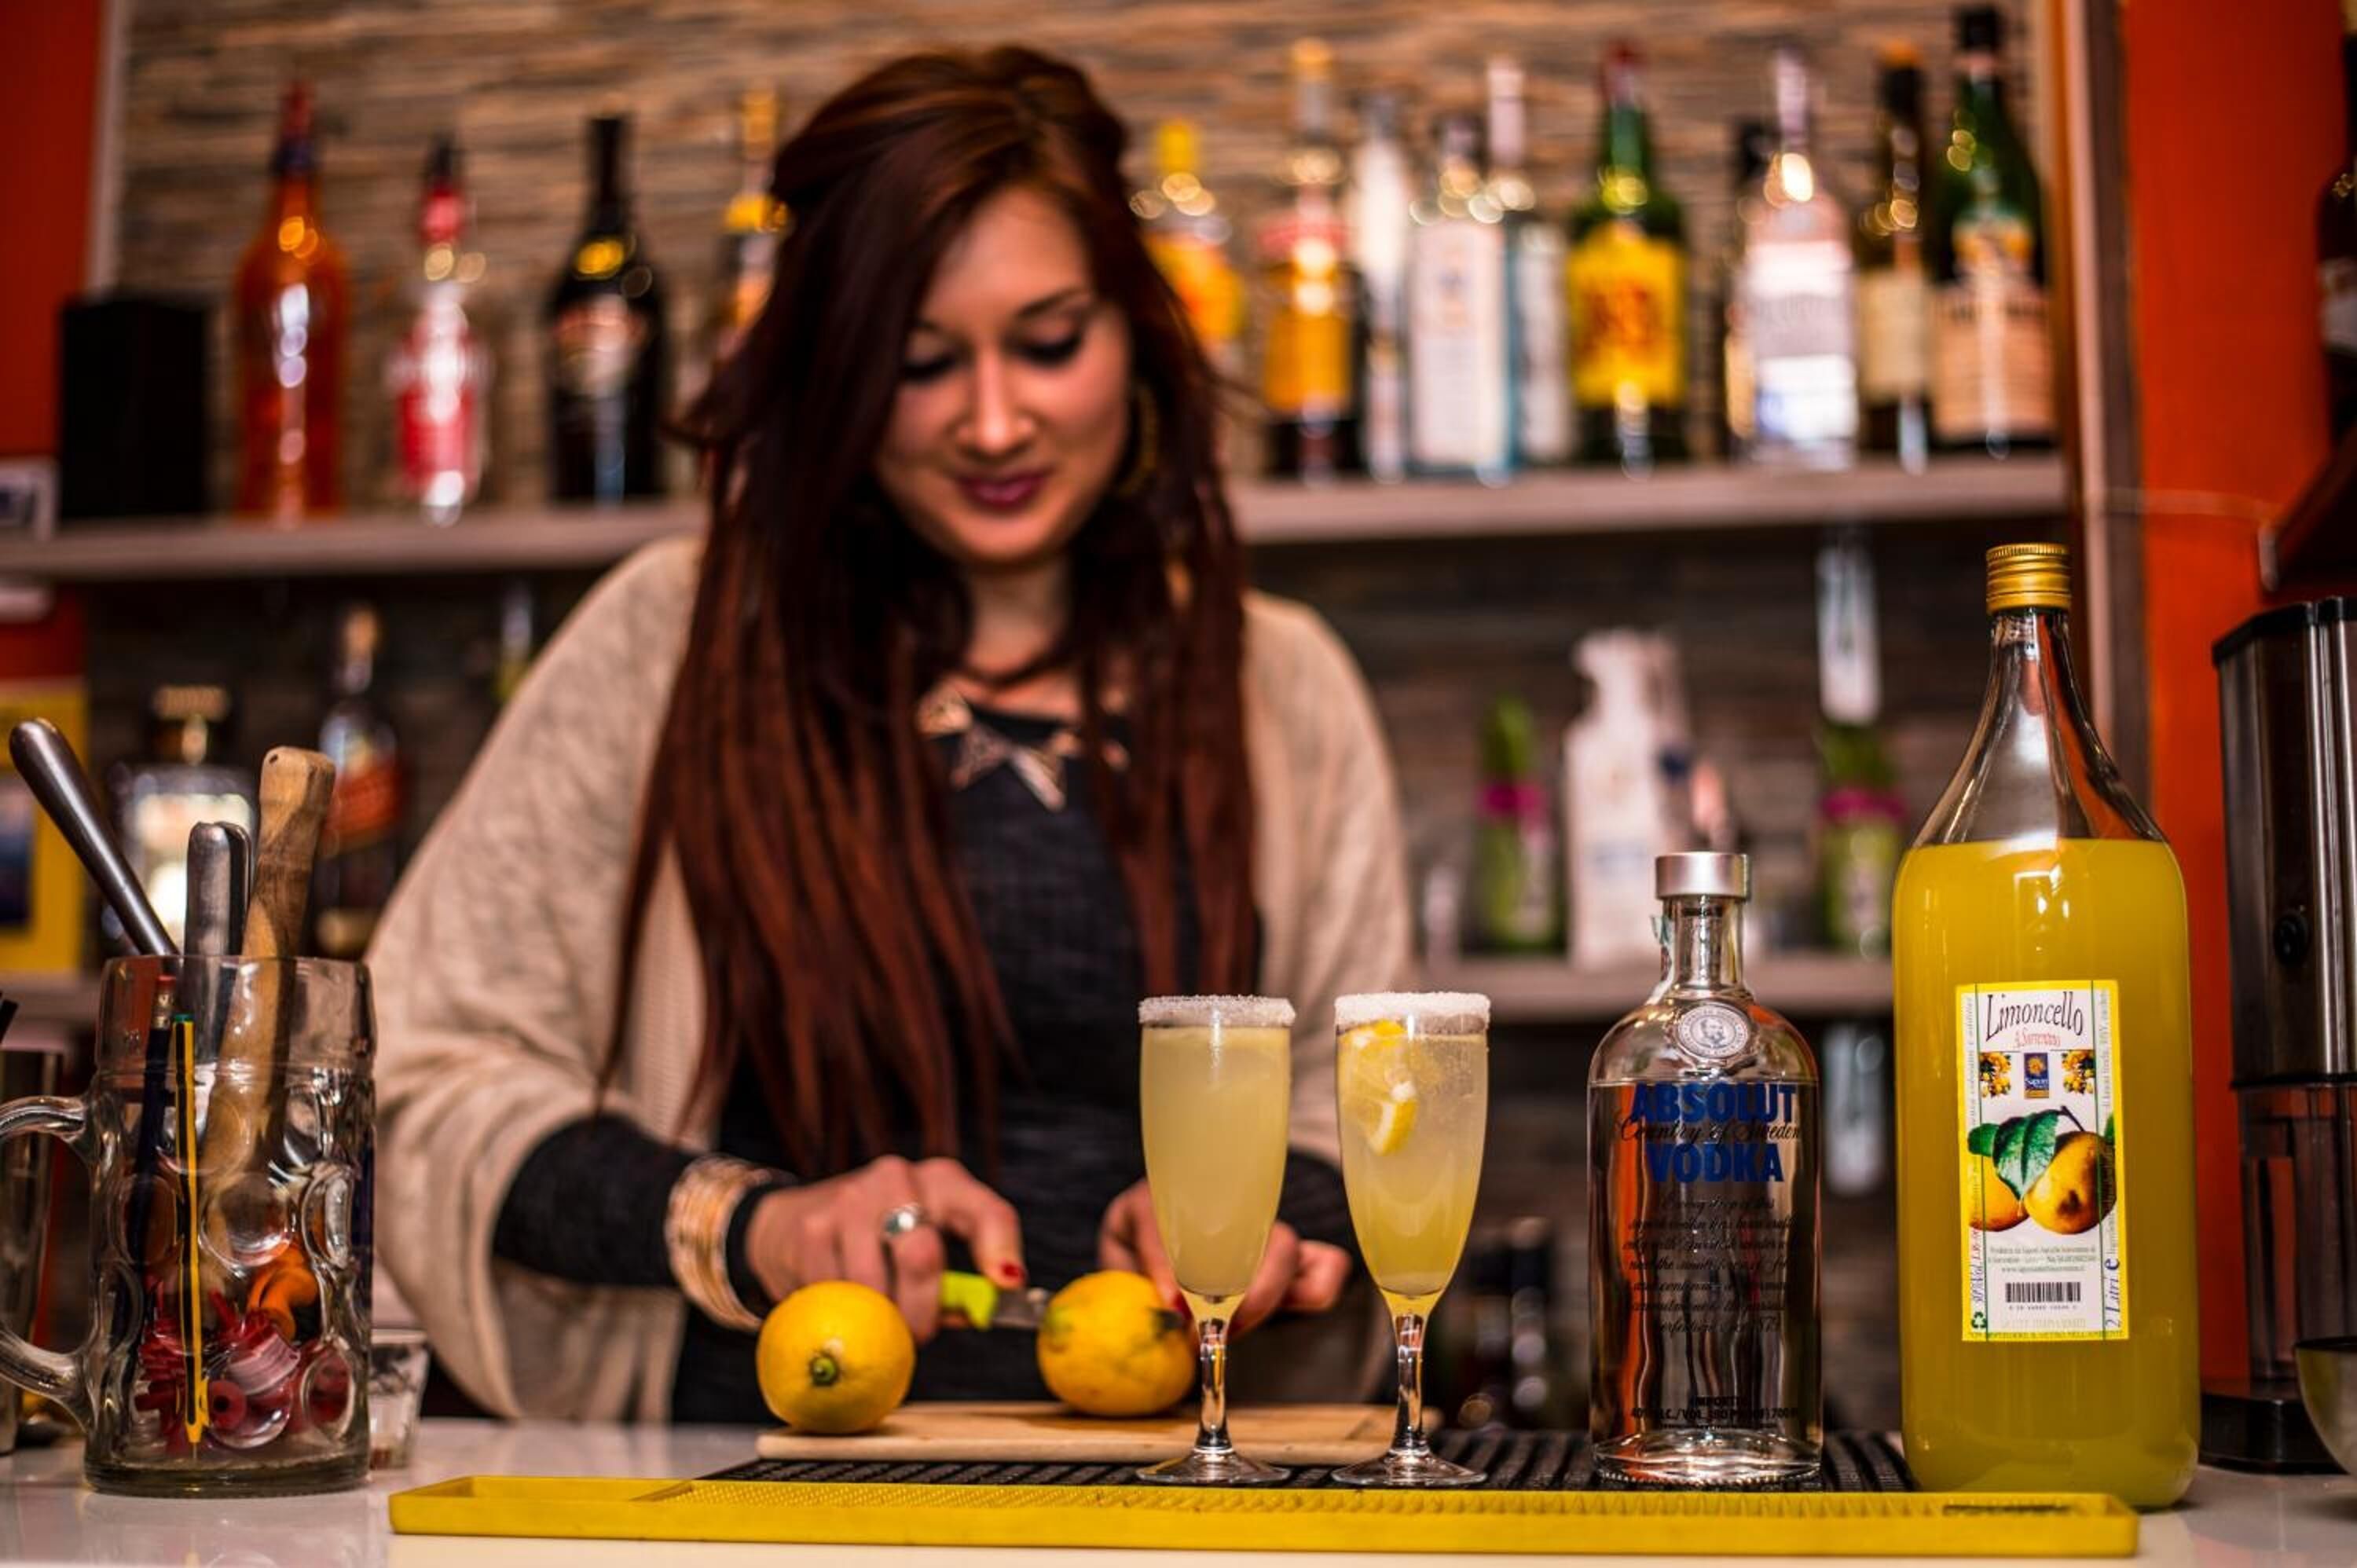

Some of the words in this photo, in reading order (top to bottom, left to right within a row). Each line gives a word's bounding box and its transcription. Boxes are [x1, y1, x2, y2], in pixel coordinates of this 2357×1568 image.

[1986, 991, 2084, 1042] Limoncello
[1629, 1081, 1798, 1123] ABSOLUT
[1645, 1142, 1784, 1182] VODKA
